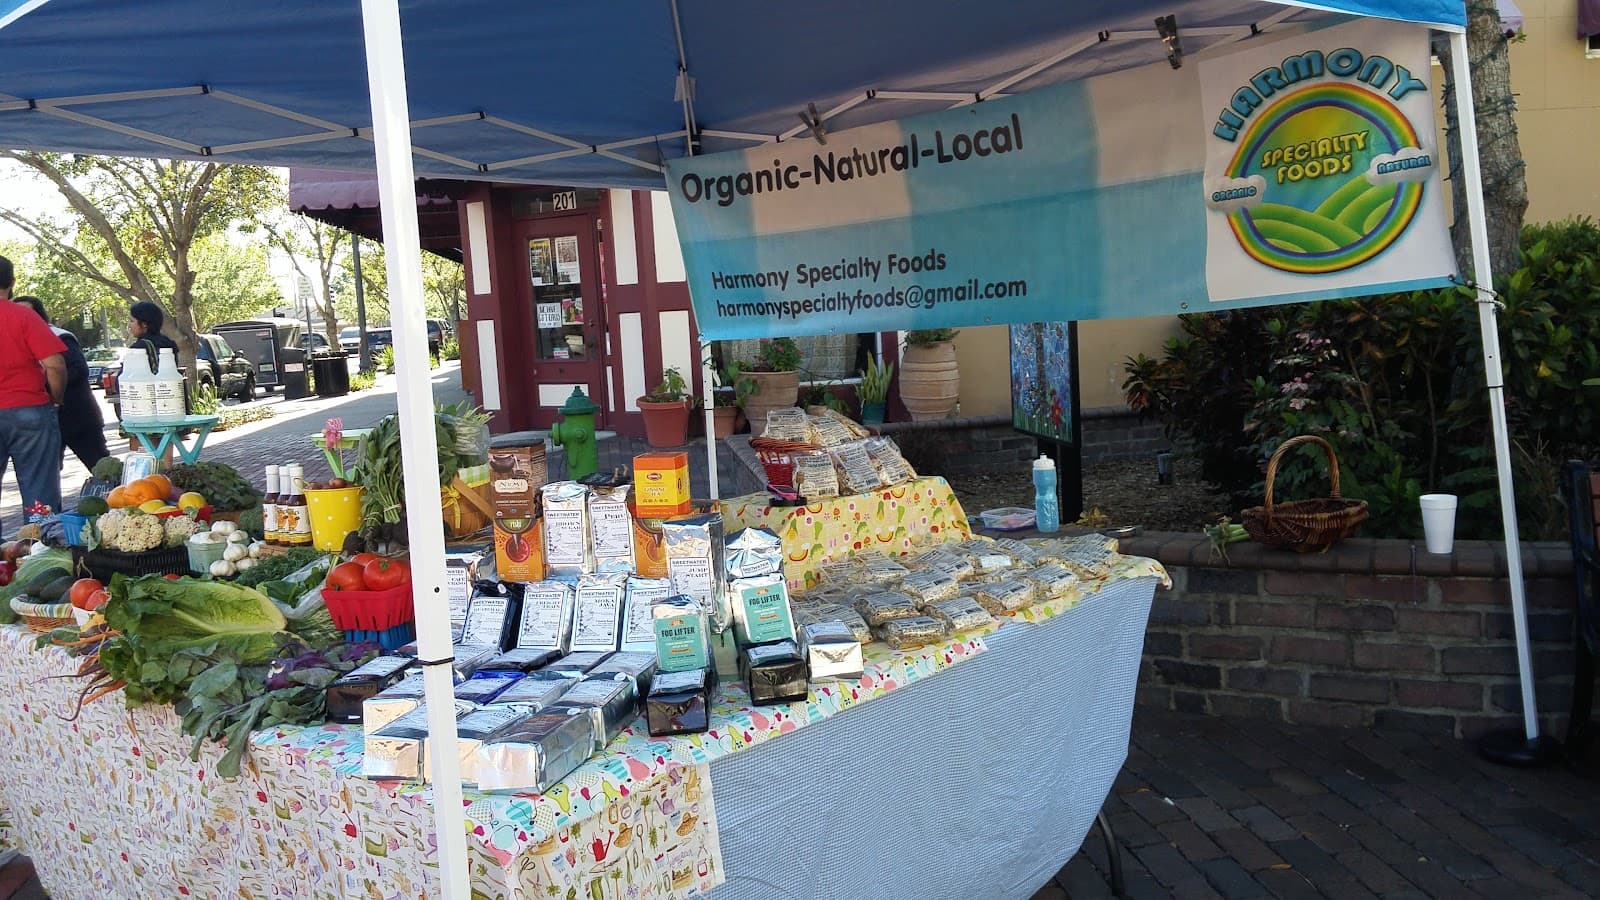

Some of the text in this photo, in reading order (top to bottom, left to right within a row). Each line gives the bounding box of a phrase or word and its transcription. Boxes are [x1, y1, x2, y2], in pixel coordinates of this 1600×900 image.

[1213, 47, 1428, 142] HARMONY
[681, 113, 1023, 207] Organic-Natural-Local
[1260, 129, 1369, 169] SPECIALTY
[1276, 154, 1353, 185] FOODS
[1376, 155, 1432, 175] NATURAL
[553, 192, 575, 210] 201
[1211, 185, 1258, 202] ORGANIC
[711, 248, 947, 292] Harmony Specialty Foods
[716, 277, 1027, 320] harmonyspecialtyfoods@gmail.com
[749, 593, 781, 606] FOG LIFTER
[661, 626, 695, 637] FOG LIFTER
